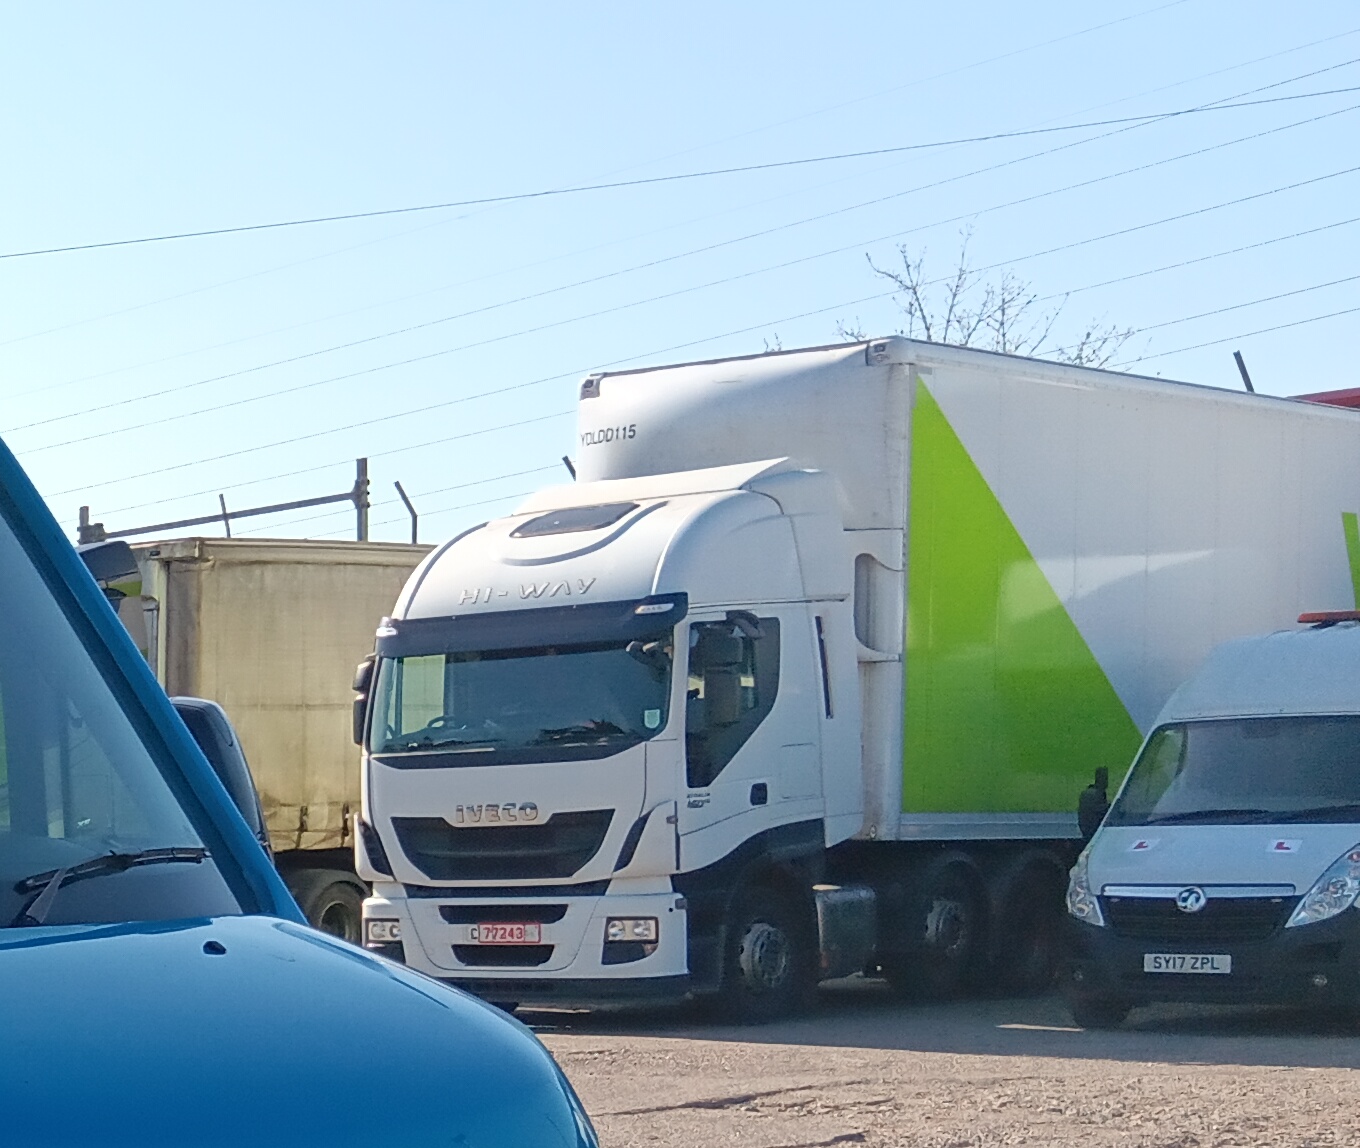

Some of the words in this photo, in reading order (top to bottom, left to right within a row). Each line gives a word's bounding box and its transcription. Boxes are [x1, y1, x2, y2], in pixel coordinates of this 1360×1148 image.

[455, 802, 539, 824] IVECO
[1153, 956, 1186, 970] SY17
[1191, 957, 1220, 970] ZPL
